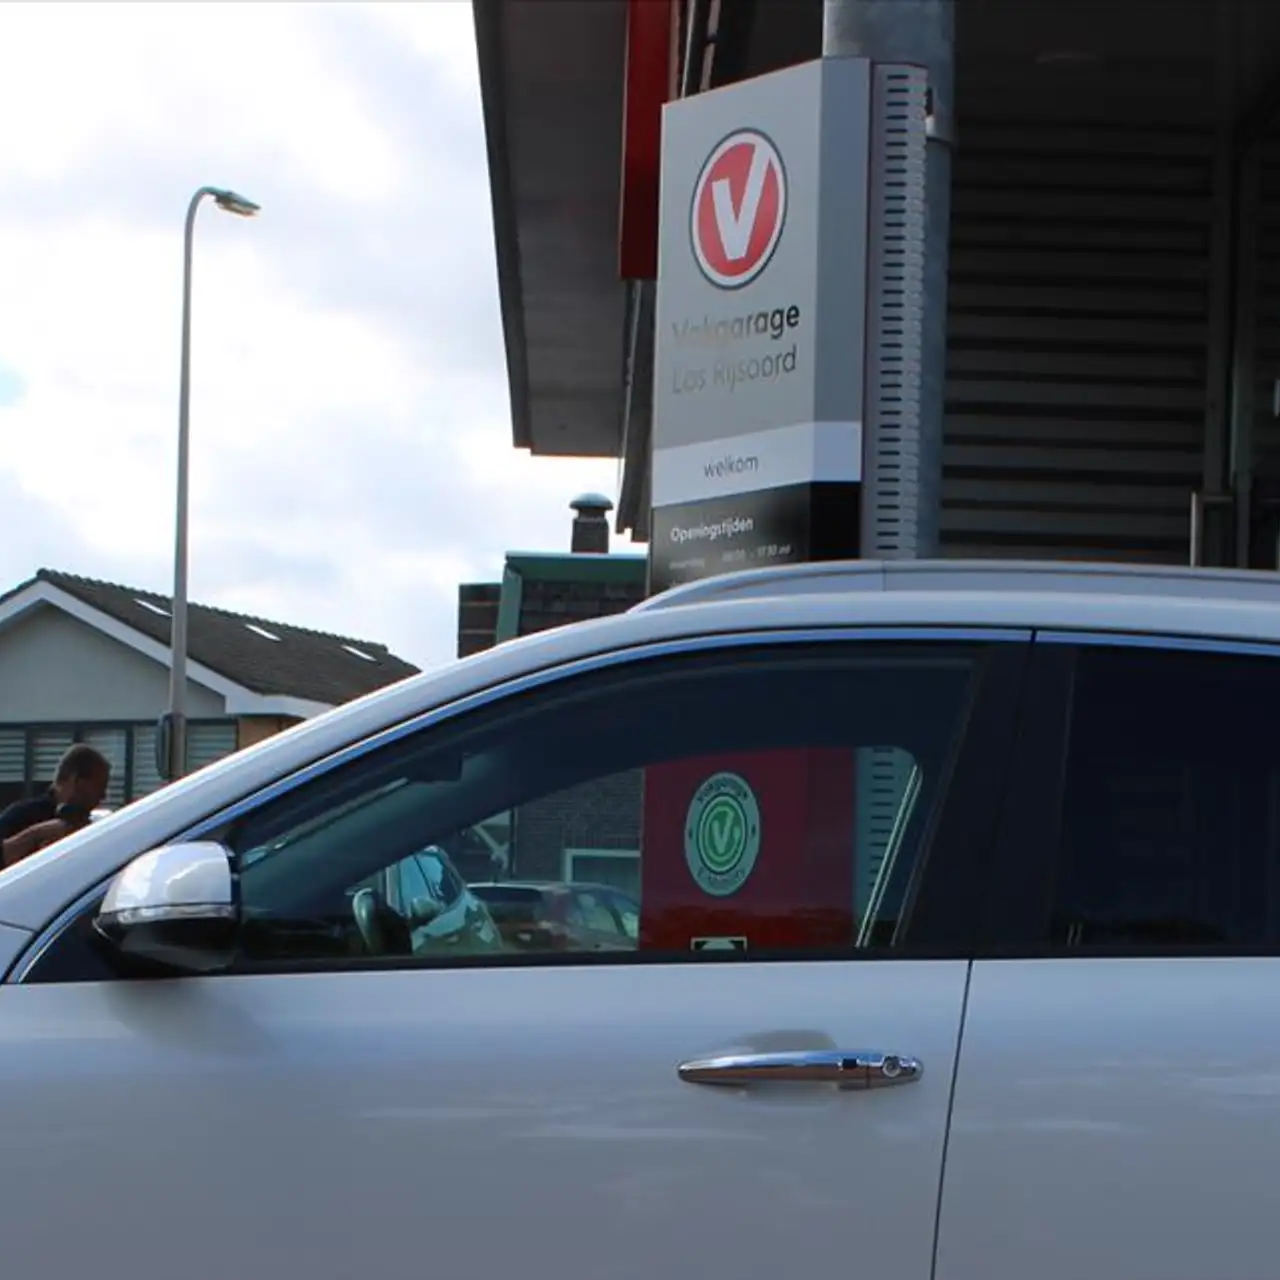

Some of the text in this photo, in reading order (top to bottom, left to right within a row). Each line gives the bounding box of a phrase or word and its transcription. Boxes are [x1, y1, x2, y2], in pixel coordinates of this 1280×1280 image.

[672, 304, 800, 344] Vakgarage
[704, 453, 759, 479] welkom
[670, 516, 754, 544] Openingstijden
